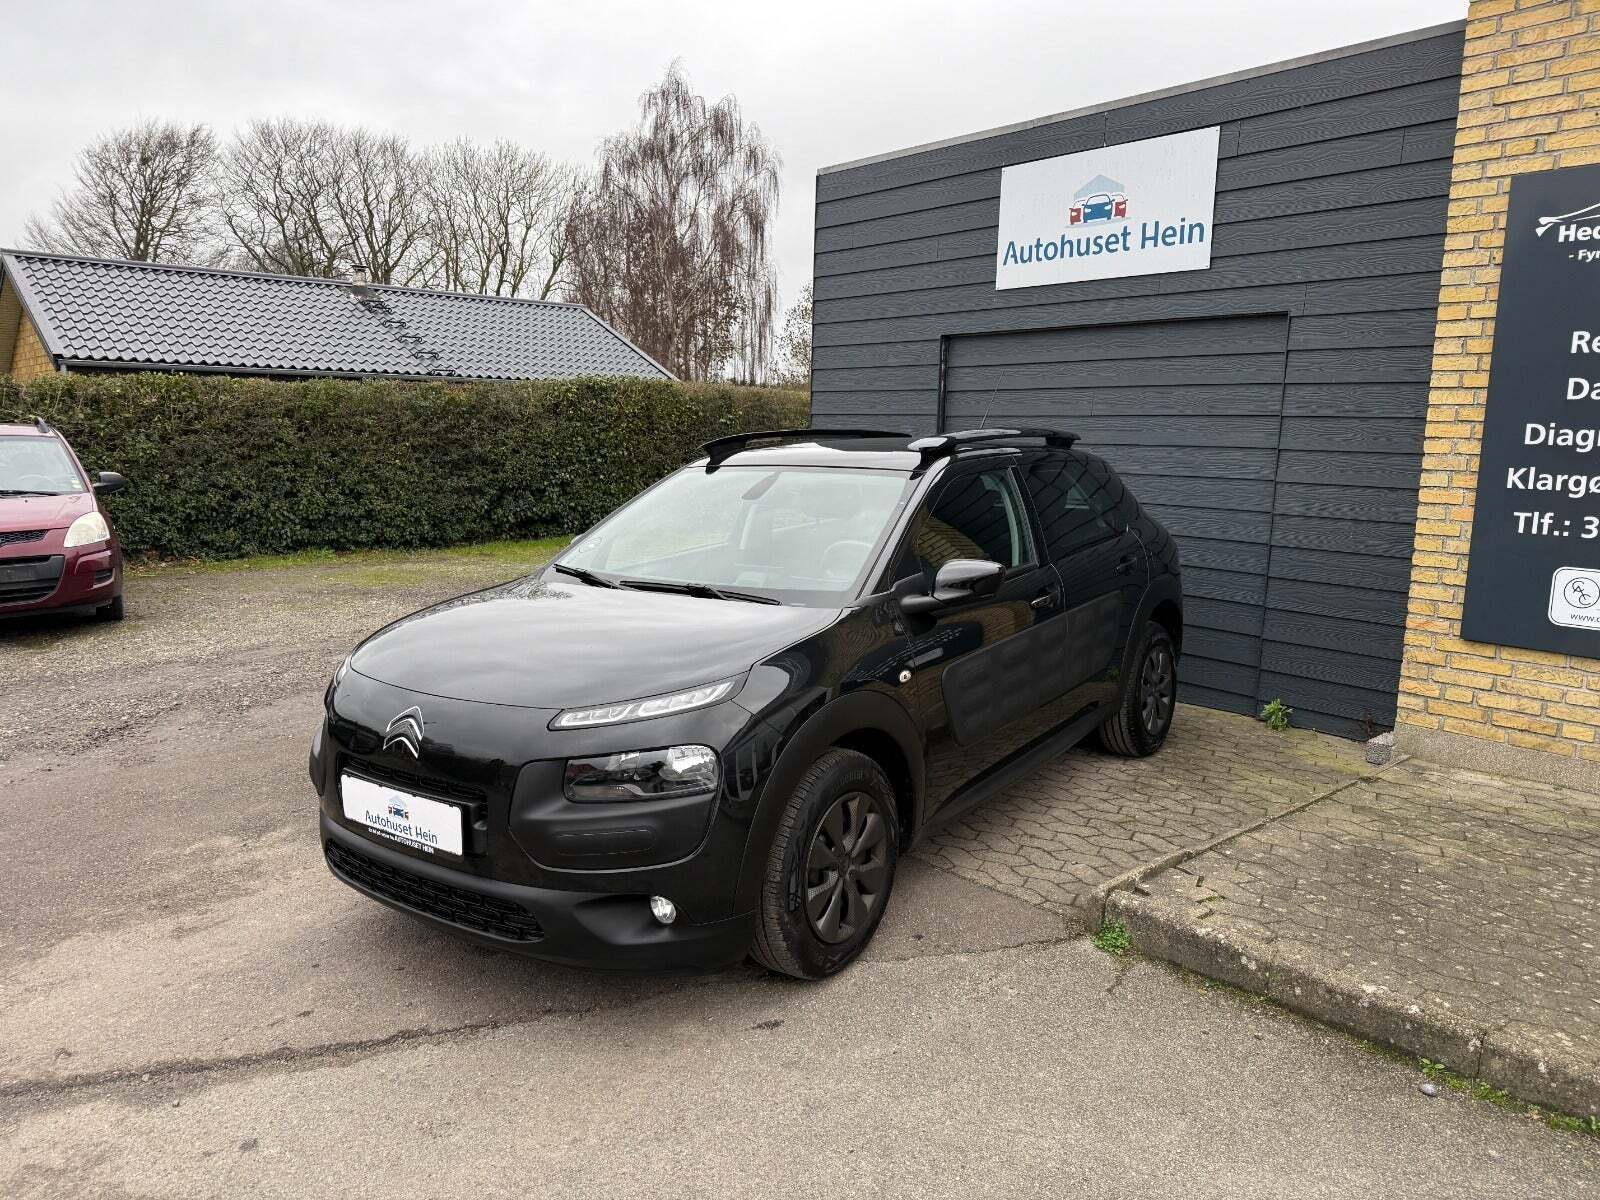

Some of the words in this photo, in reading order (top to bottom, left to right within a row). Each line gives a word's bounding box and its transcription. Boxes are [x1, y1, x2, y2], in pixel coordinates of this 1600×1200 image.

[1003, 225, 1131, 266] Autohuset
[1140, 217, 1205, 250] Hein
[1524, 422, 1600, 453] Diag
[1513, 511, 1571, 537] Tlf.:
[365, 810, 413, 836] Autohuset
[415, 825, 438, 845] Hein
